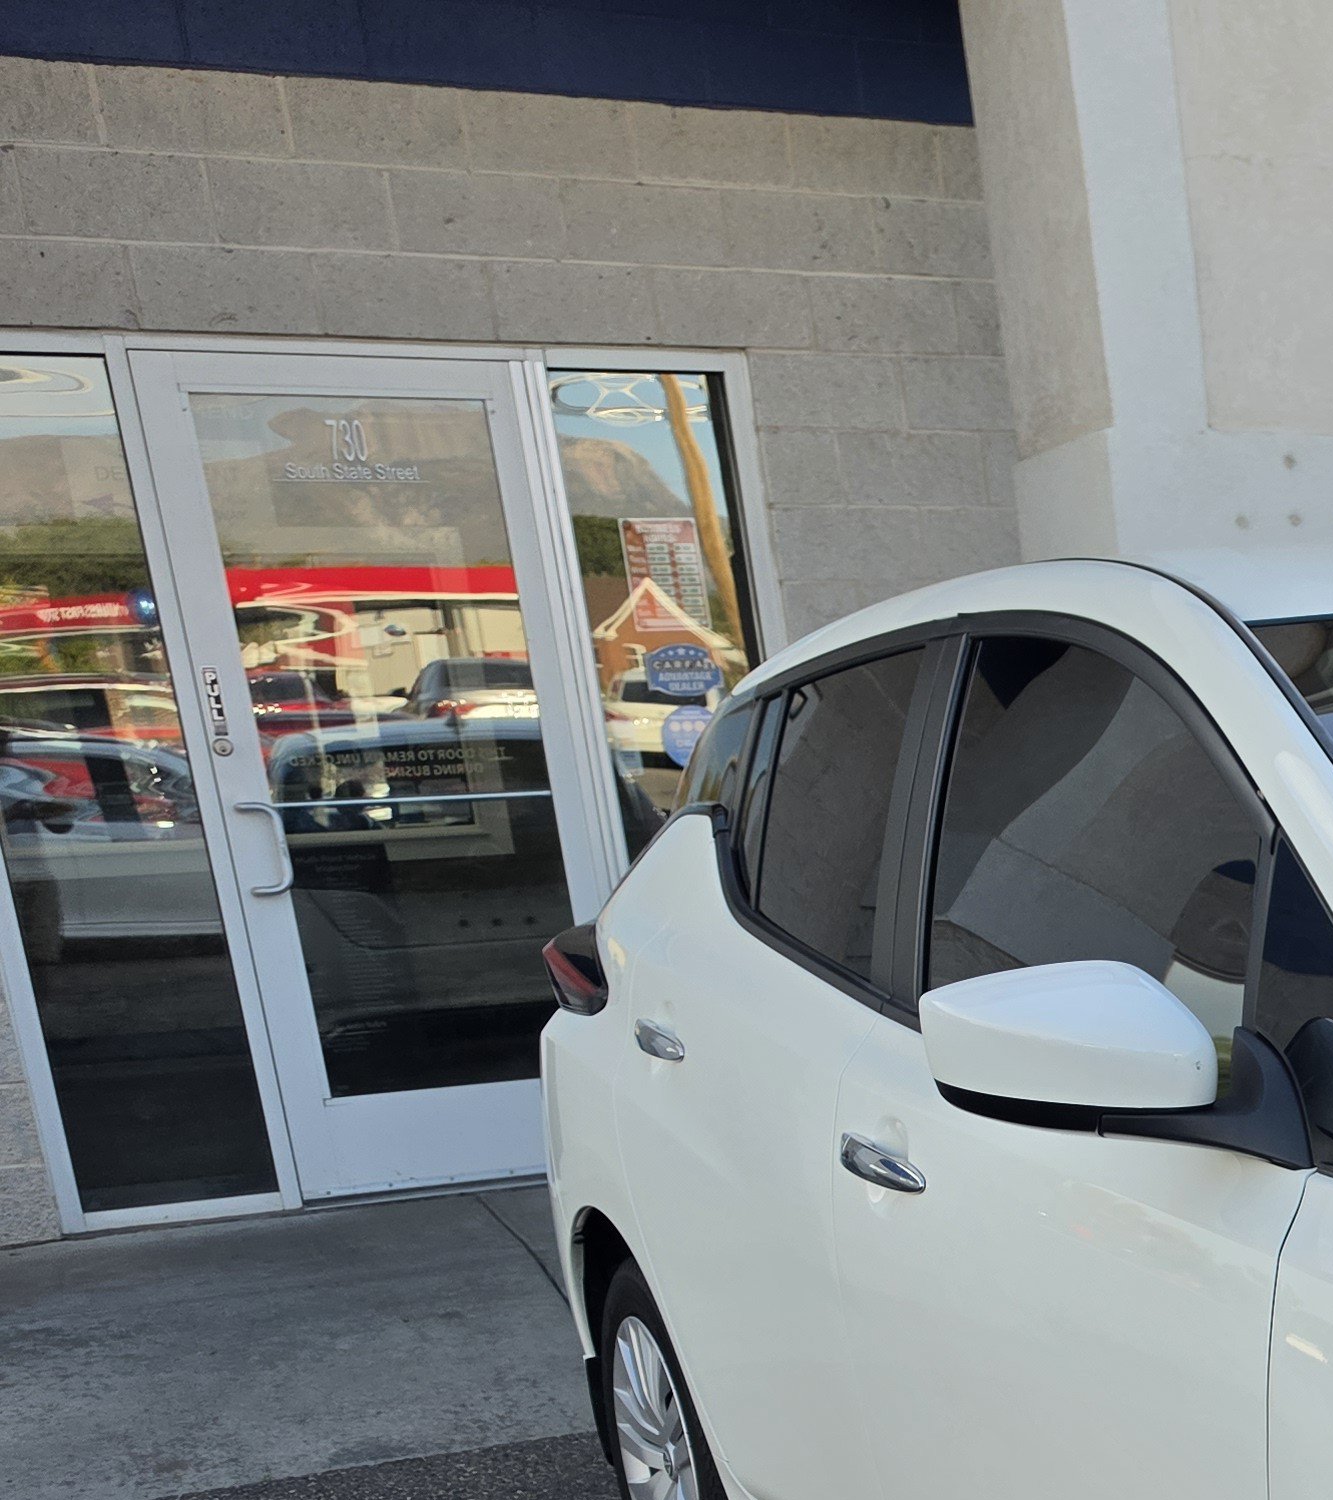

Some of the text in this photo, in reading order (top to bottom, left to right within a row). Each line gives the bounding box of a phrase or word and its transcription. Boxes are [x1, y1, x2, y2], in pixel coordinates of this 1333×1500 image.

[324, 419, 369, 461] 730
[285, 462, 420, 480] South State Street
[204, 672, 225, 721] PULL
